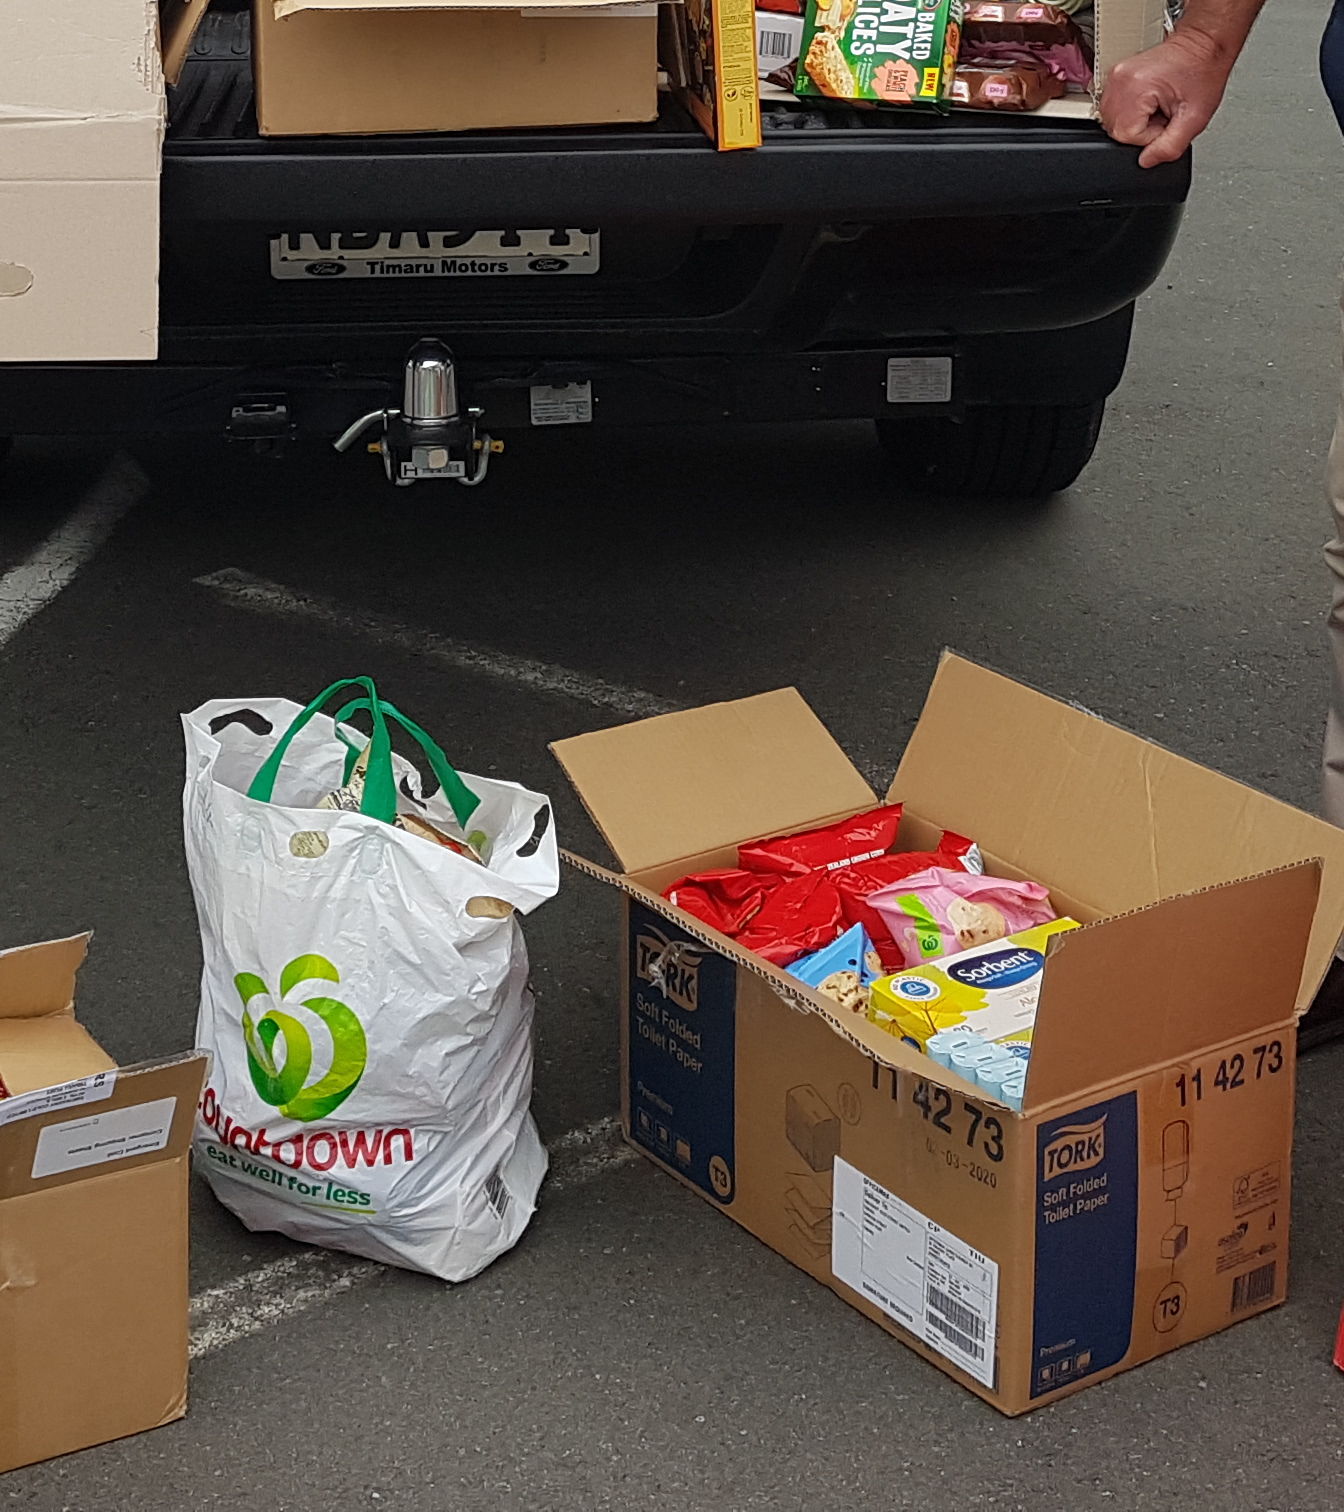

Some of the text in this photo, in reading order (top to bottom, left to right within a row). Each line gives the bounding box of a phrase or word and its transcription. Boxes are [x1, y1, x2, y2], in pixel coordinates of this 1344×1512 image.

[912, 12, 935, 60] BAKED
[923, 70, 936, 91] NEW
[366, 259, 509, 275] Timaru Motors
[957, 951, 1035, 982] Sorbent
[636, 993, 701, 1051] Soft Folded
[636, 1015, 703, 1074] Toilet Paper
[1175, 1040, 1284, 1108] 11 42 73
[913, 1079, 952, 1134] 42
[966, 1104, 1005, 1163] 73
[1045, 1131, 1103, 1170] TORK
[206, 1142, 372, 1208] eat well for less
[713, 1164, 731, 1187] T3
[1043, 1172, 1108, 1208] Soft Folded
[1043, 1191, 1110, 1225] Toilet Paper
[1159, 1296, 1180, 1318] T3
